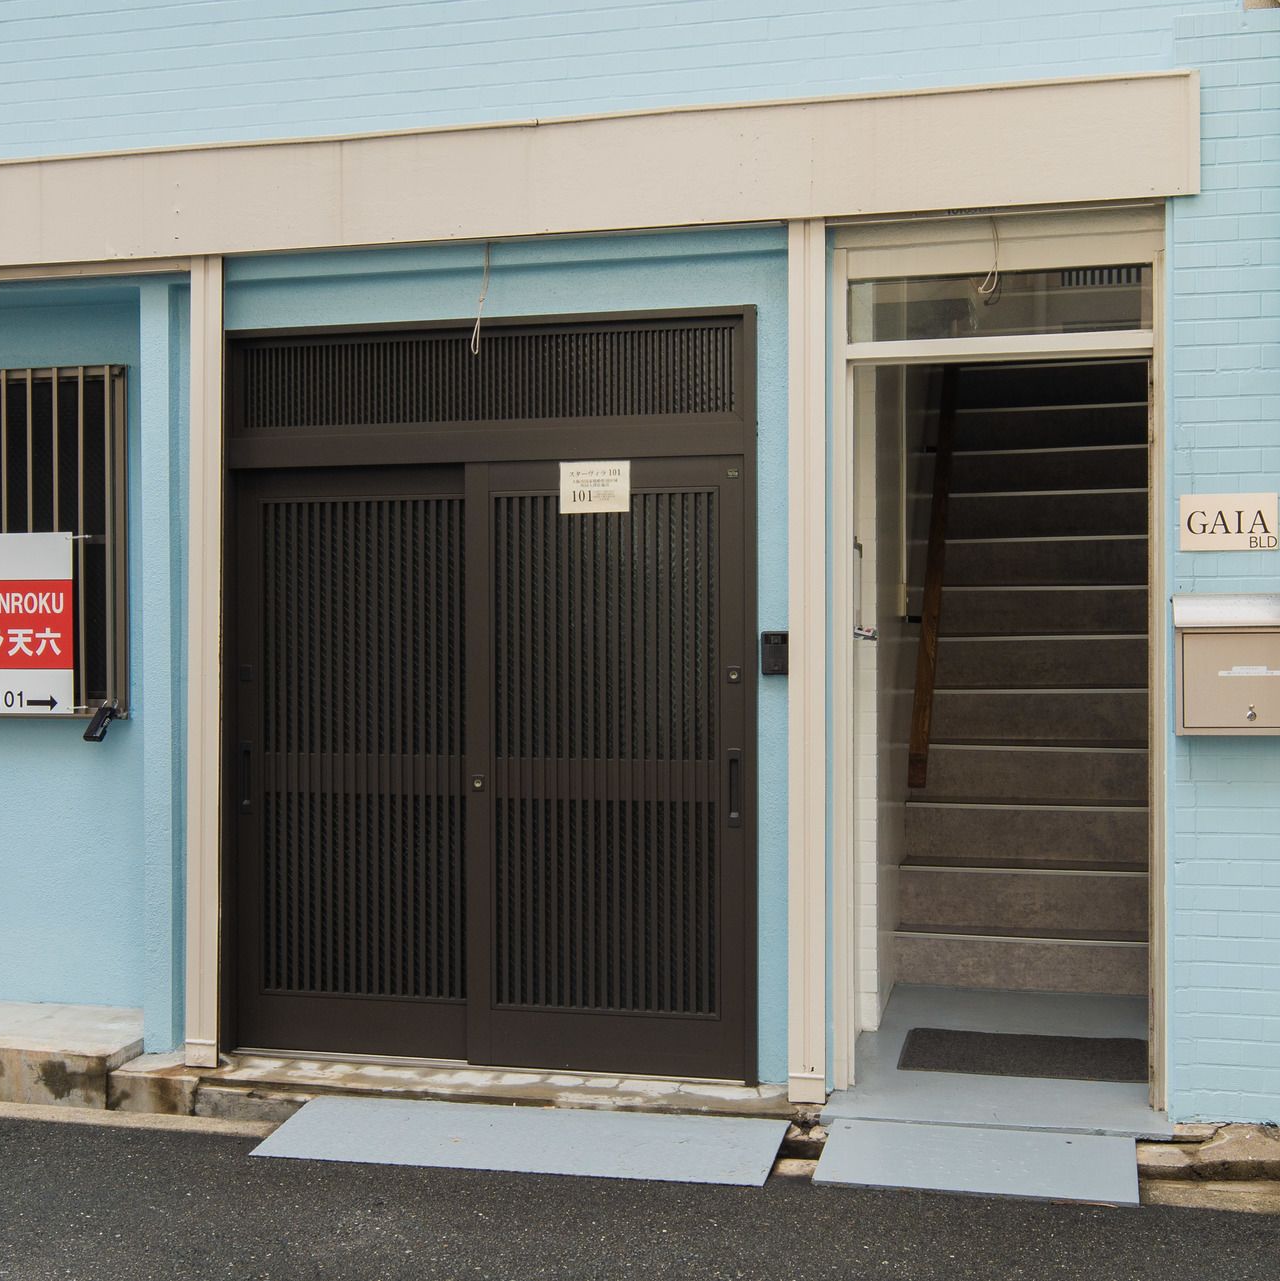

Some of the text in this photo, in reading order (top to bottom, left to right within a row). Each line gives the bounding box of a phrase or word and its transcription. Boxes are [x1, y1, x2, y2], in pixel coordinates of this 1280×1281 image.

[608, 469, 621, 477] 101
[572, 490, 592, 502] 101
[1186, 510, 1271, 535] GAIA
[1249, 535, 1278, 549] BLD
